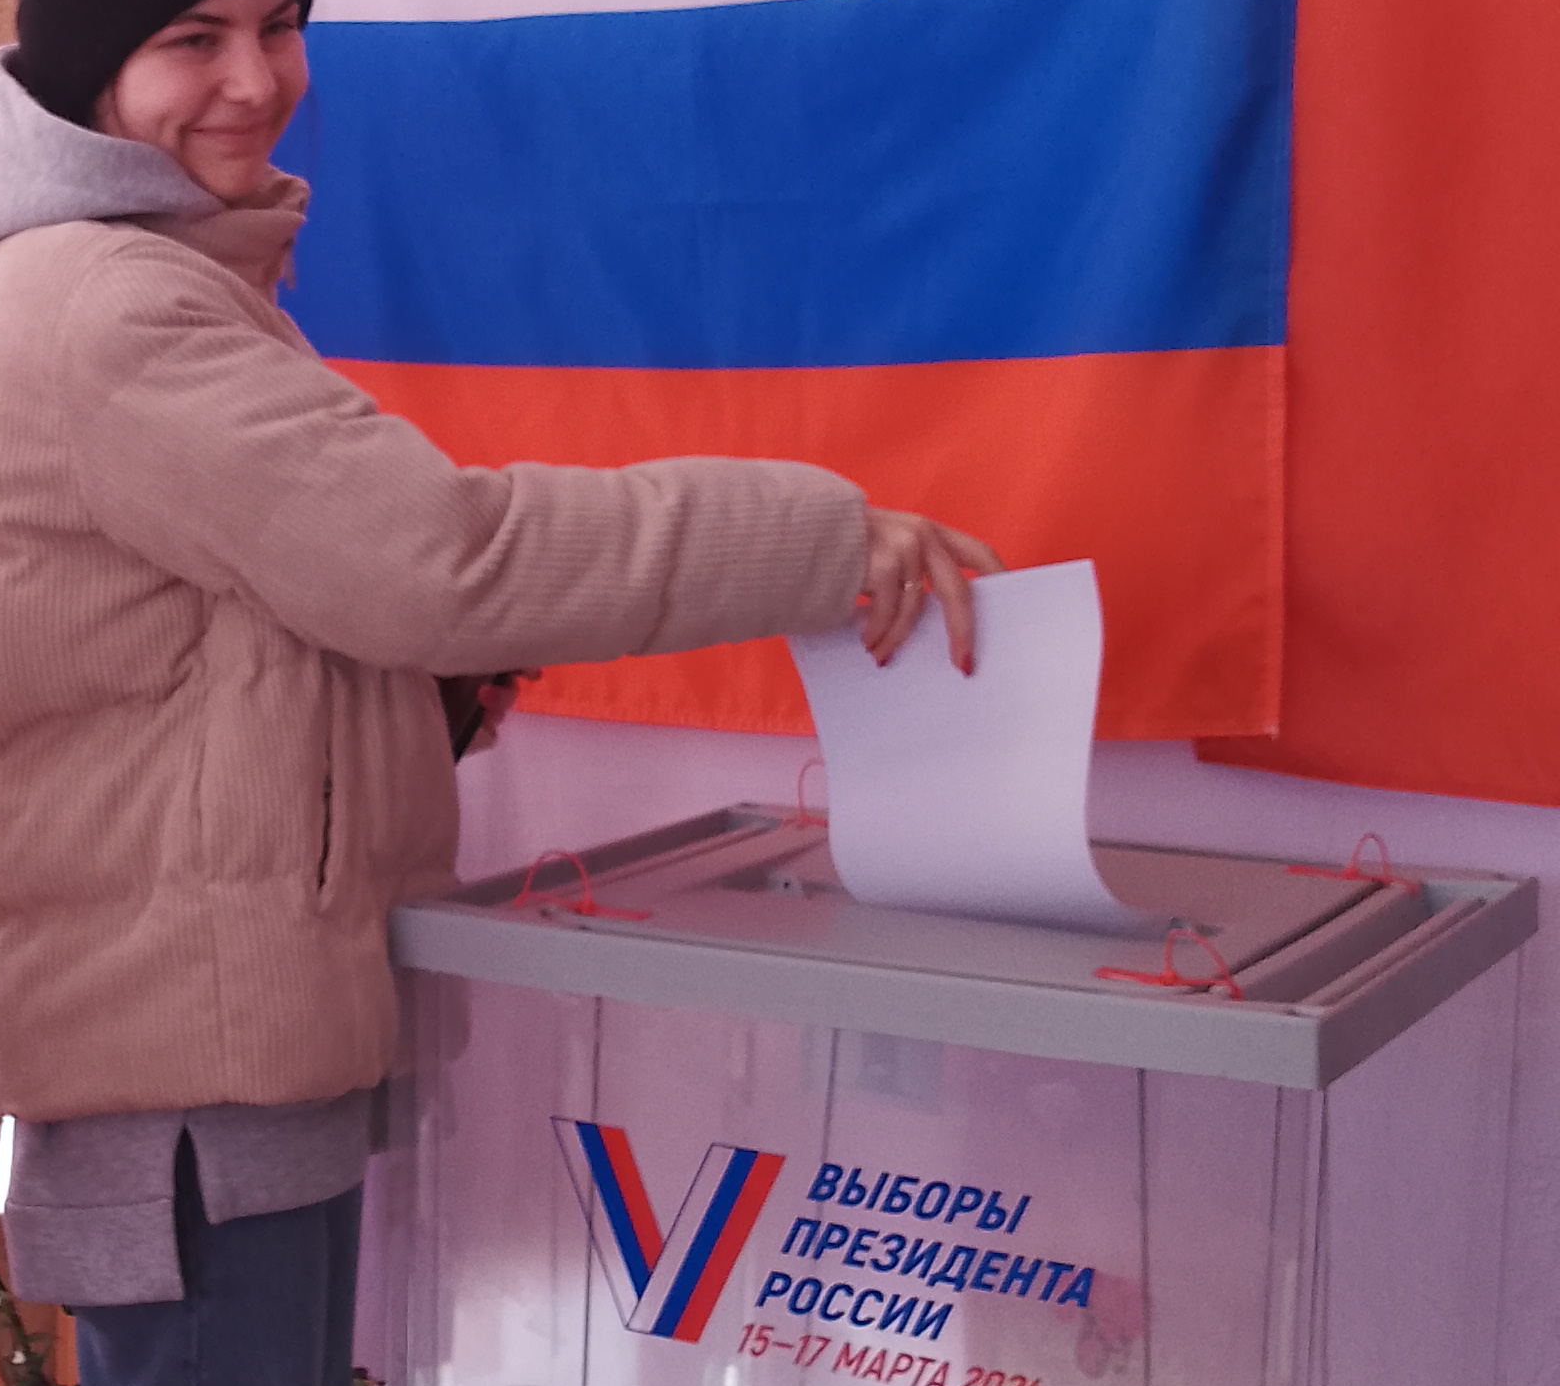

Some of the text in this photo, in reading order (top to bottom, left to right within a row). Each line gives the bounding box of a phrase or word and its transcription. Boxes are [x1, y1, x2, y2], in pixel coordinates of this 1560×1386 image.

[807, 1162, 1032, 1235] ВЫБОРЫ
[781, 1216, 1096, 1308] ПРЕЗИДЕНТА
[755, 1271, 955, 1341] РОССИИ
